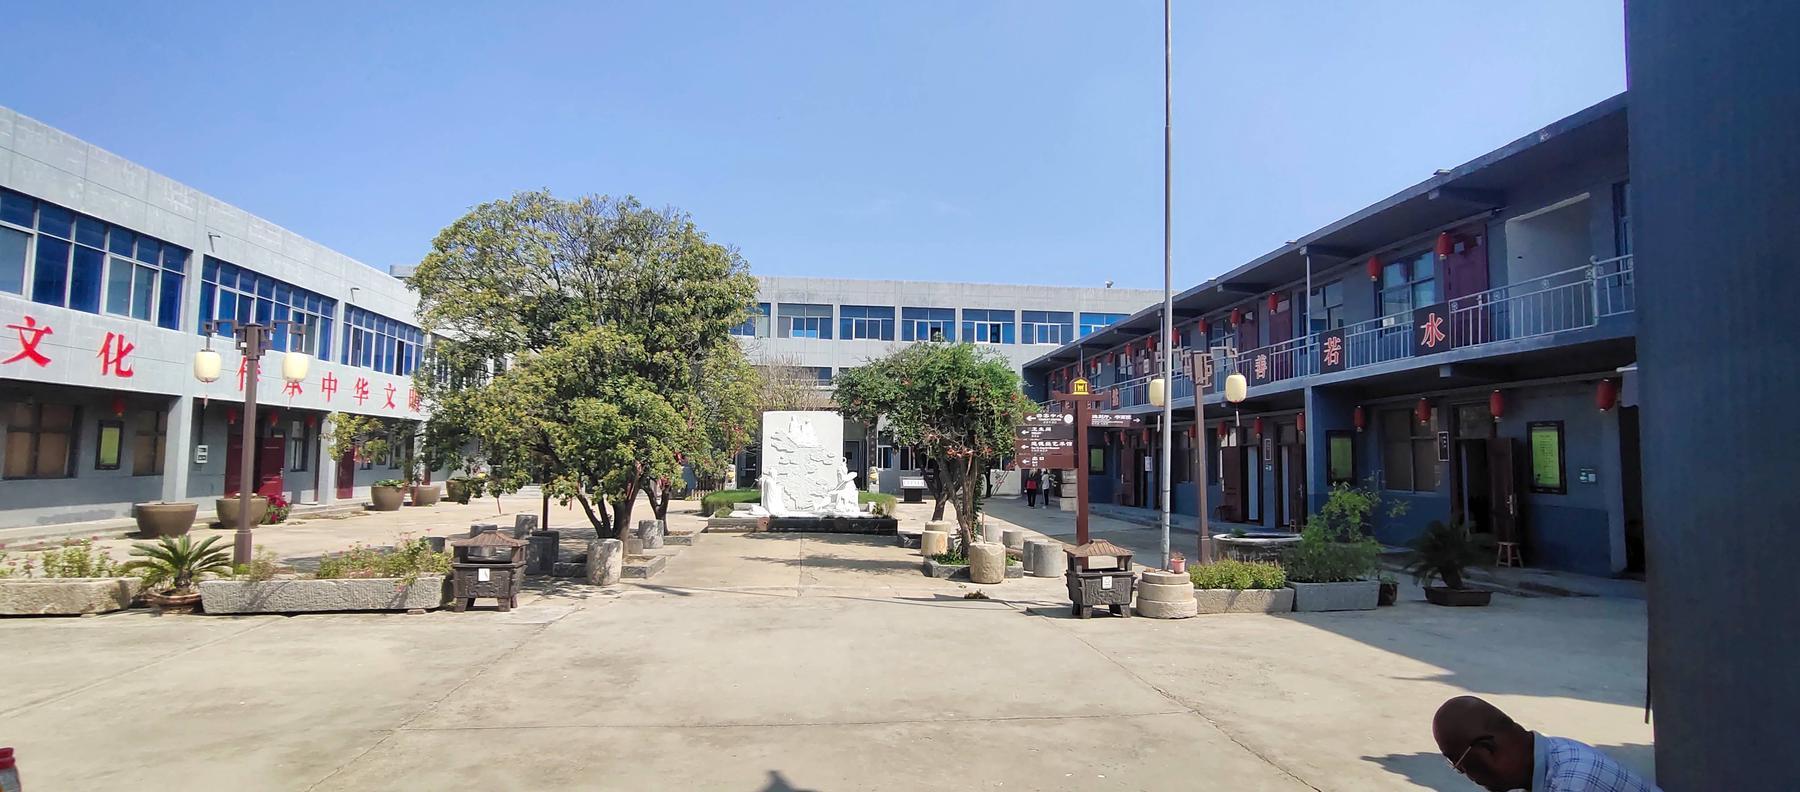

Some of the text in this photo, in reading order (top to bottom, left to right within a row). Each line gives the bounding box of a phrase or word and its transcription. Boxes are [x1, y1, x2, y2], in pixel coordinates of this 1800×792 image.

[1, 315, 135, 378] 文化
[1255, 312, 1446, 380] 善 若 水
